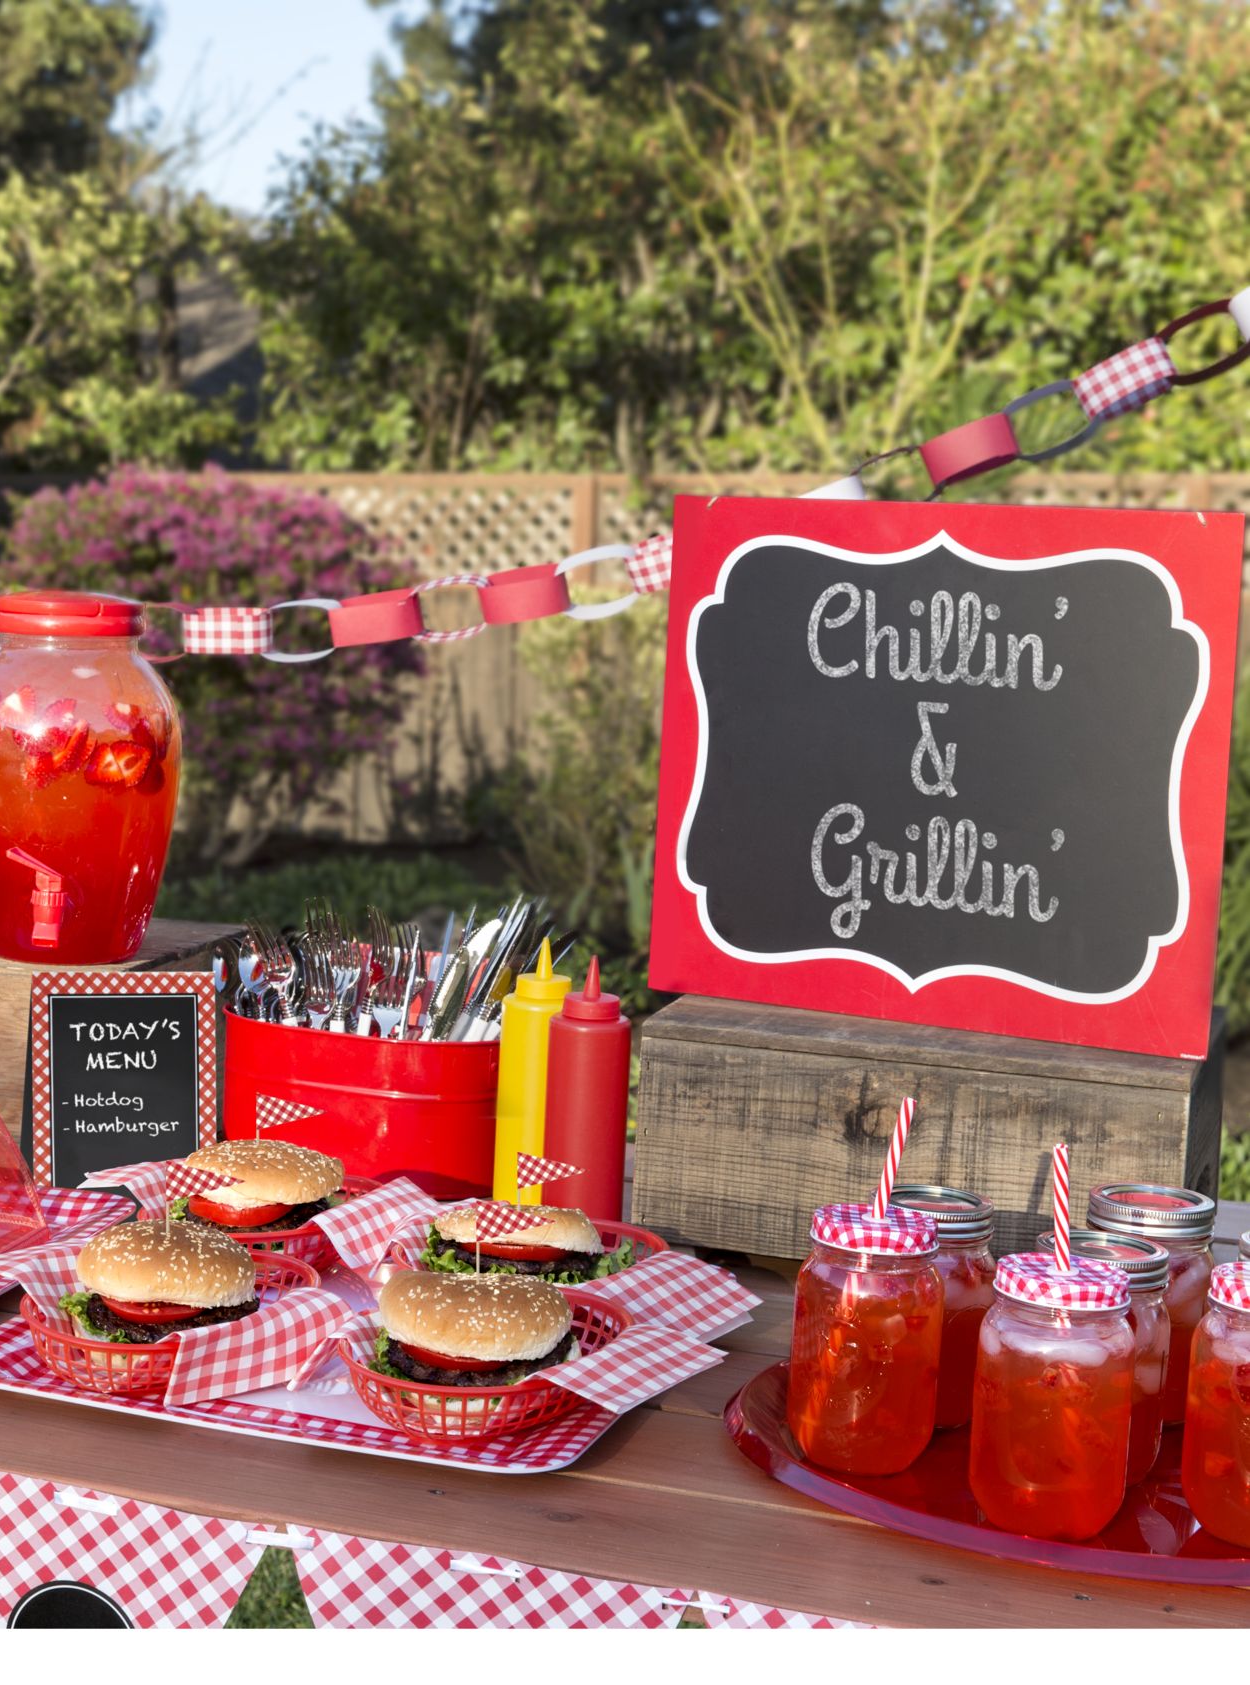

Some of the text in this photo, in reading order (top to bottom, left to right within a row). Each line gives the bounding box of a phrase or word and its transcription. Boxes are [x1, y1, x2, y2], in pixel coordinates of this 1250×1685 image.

[807, 582, 1068, 691] Chillin'
[910, 701, 958, 798] &
[810, 802, 1065, 939] Grillin'
[69, 1018, 181, 1041] TODAY'S
[86, 1050, 157, 1071] MENU
[74, 1091, 144, 1111] Hotdog
[75, 1116, 180, 1137] Hamburger
